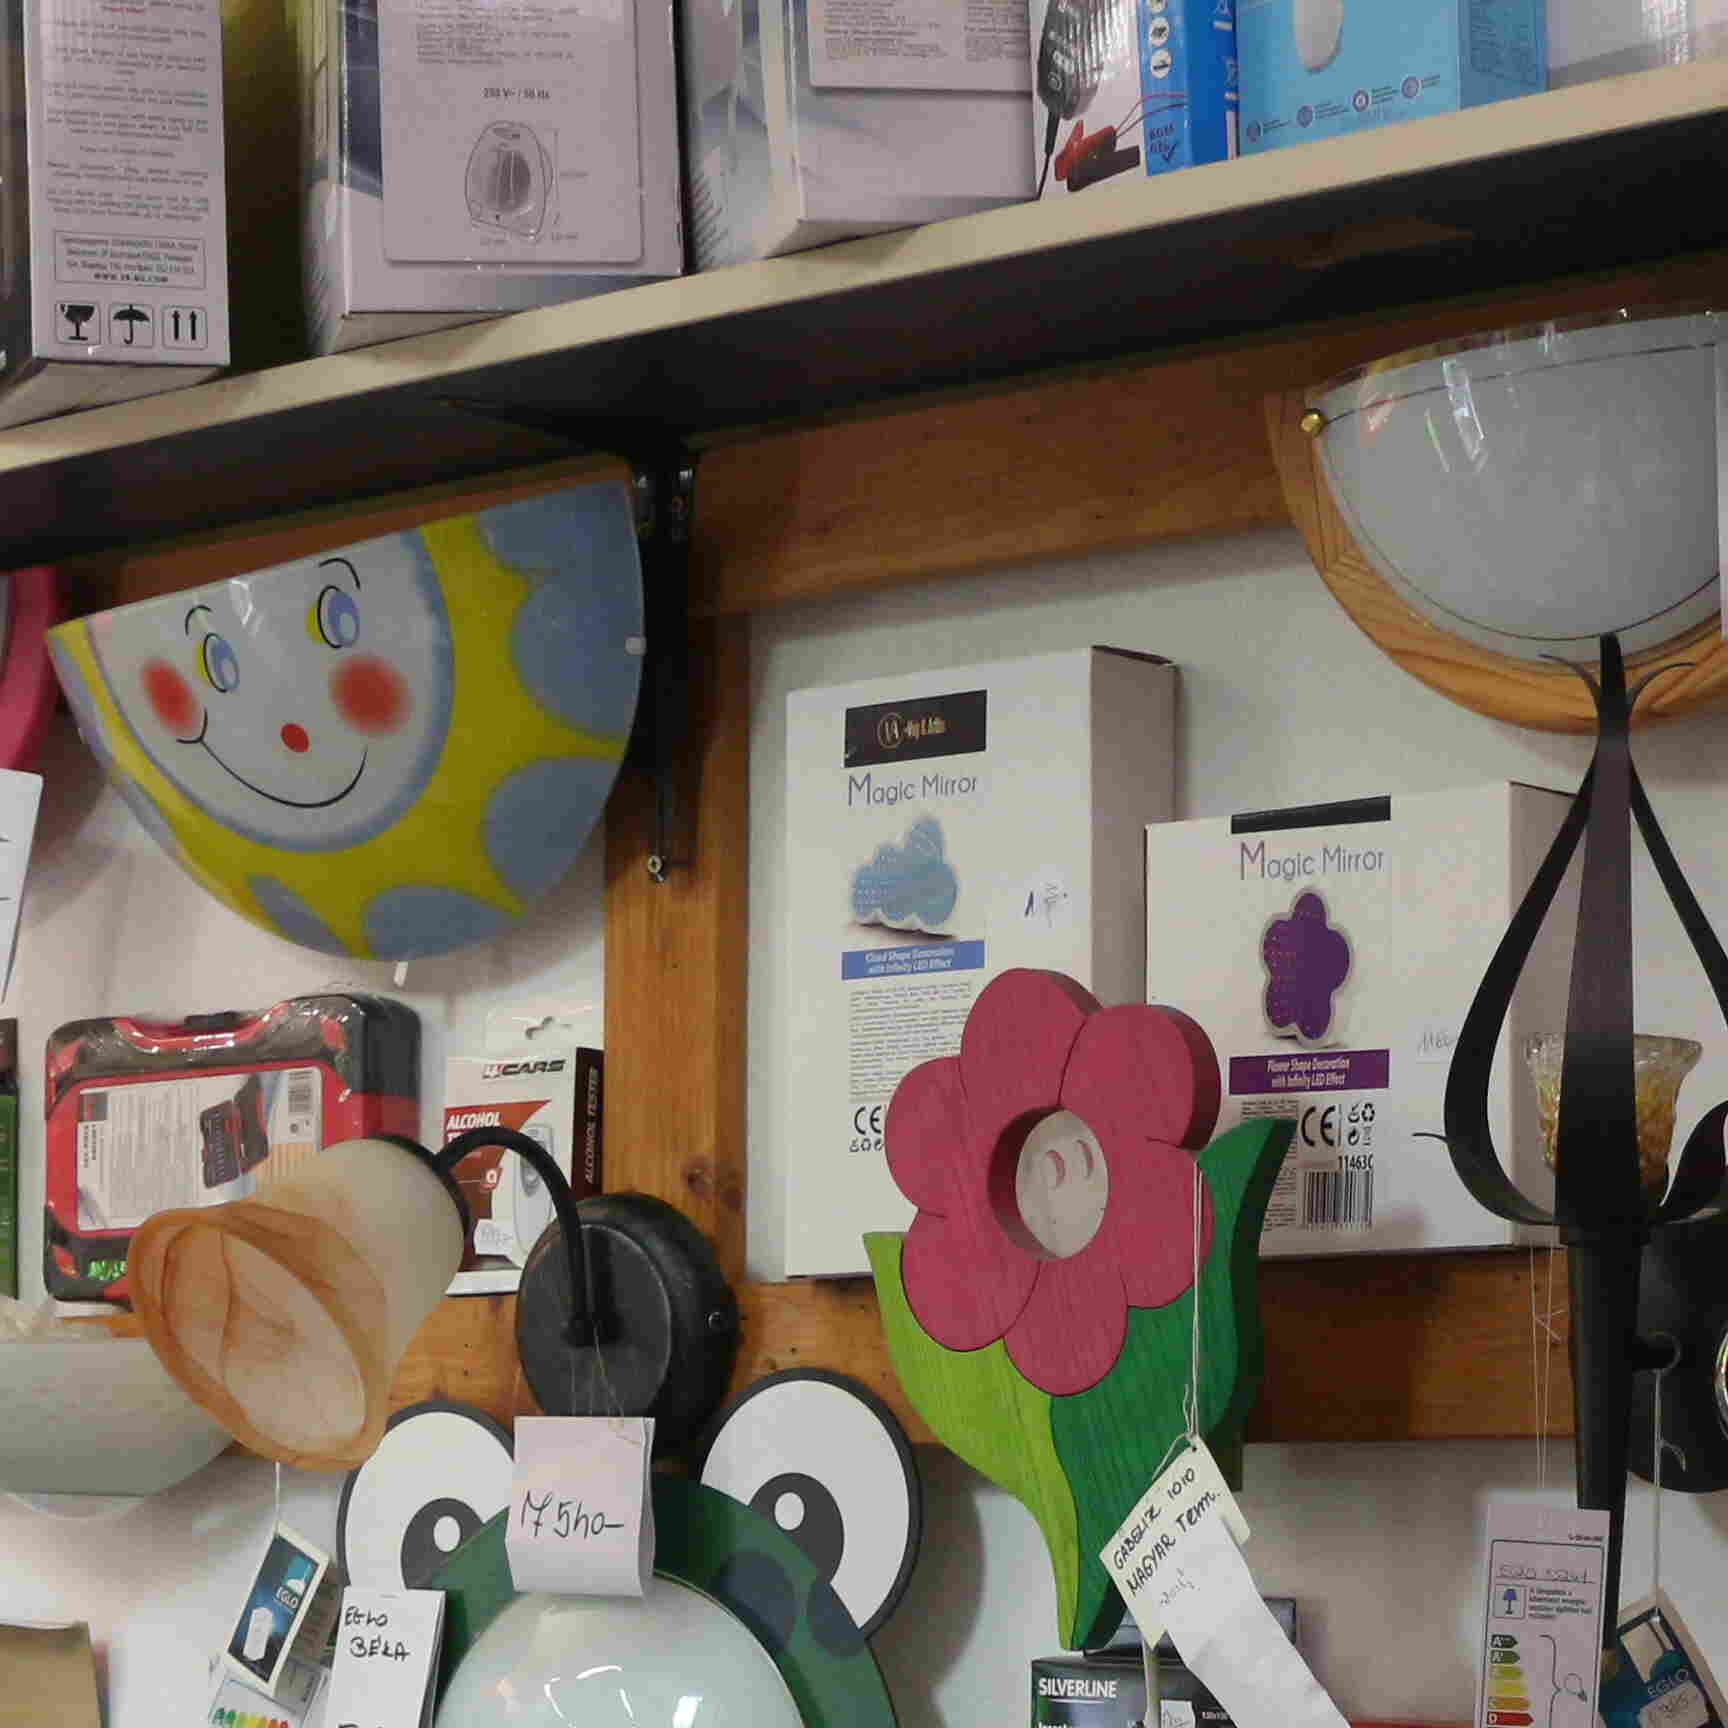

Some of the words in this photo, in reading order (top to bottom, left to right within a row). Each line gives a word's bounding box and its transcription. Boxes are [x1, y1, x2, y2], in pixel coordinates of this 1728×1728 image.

[848, 772, 916, 807] Magic
[922, 775, 977, 799] Mirror
[1240, 841, 1315, 881] Magic
[1322, 844, 1385, 875] Mirror
[447, 1112, 501, 1129] ALCOHOL
[1126, 1534, 1176, 1597] MAGYAR
[1039, 1678, 1117, 1698] SILVERLINE
